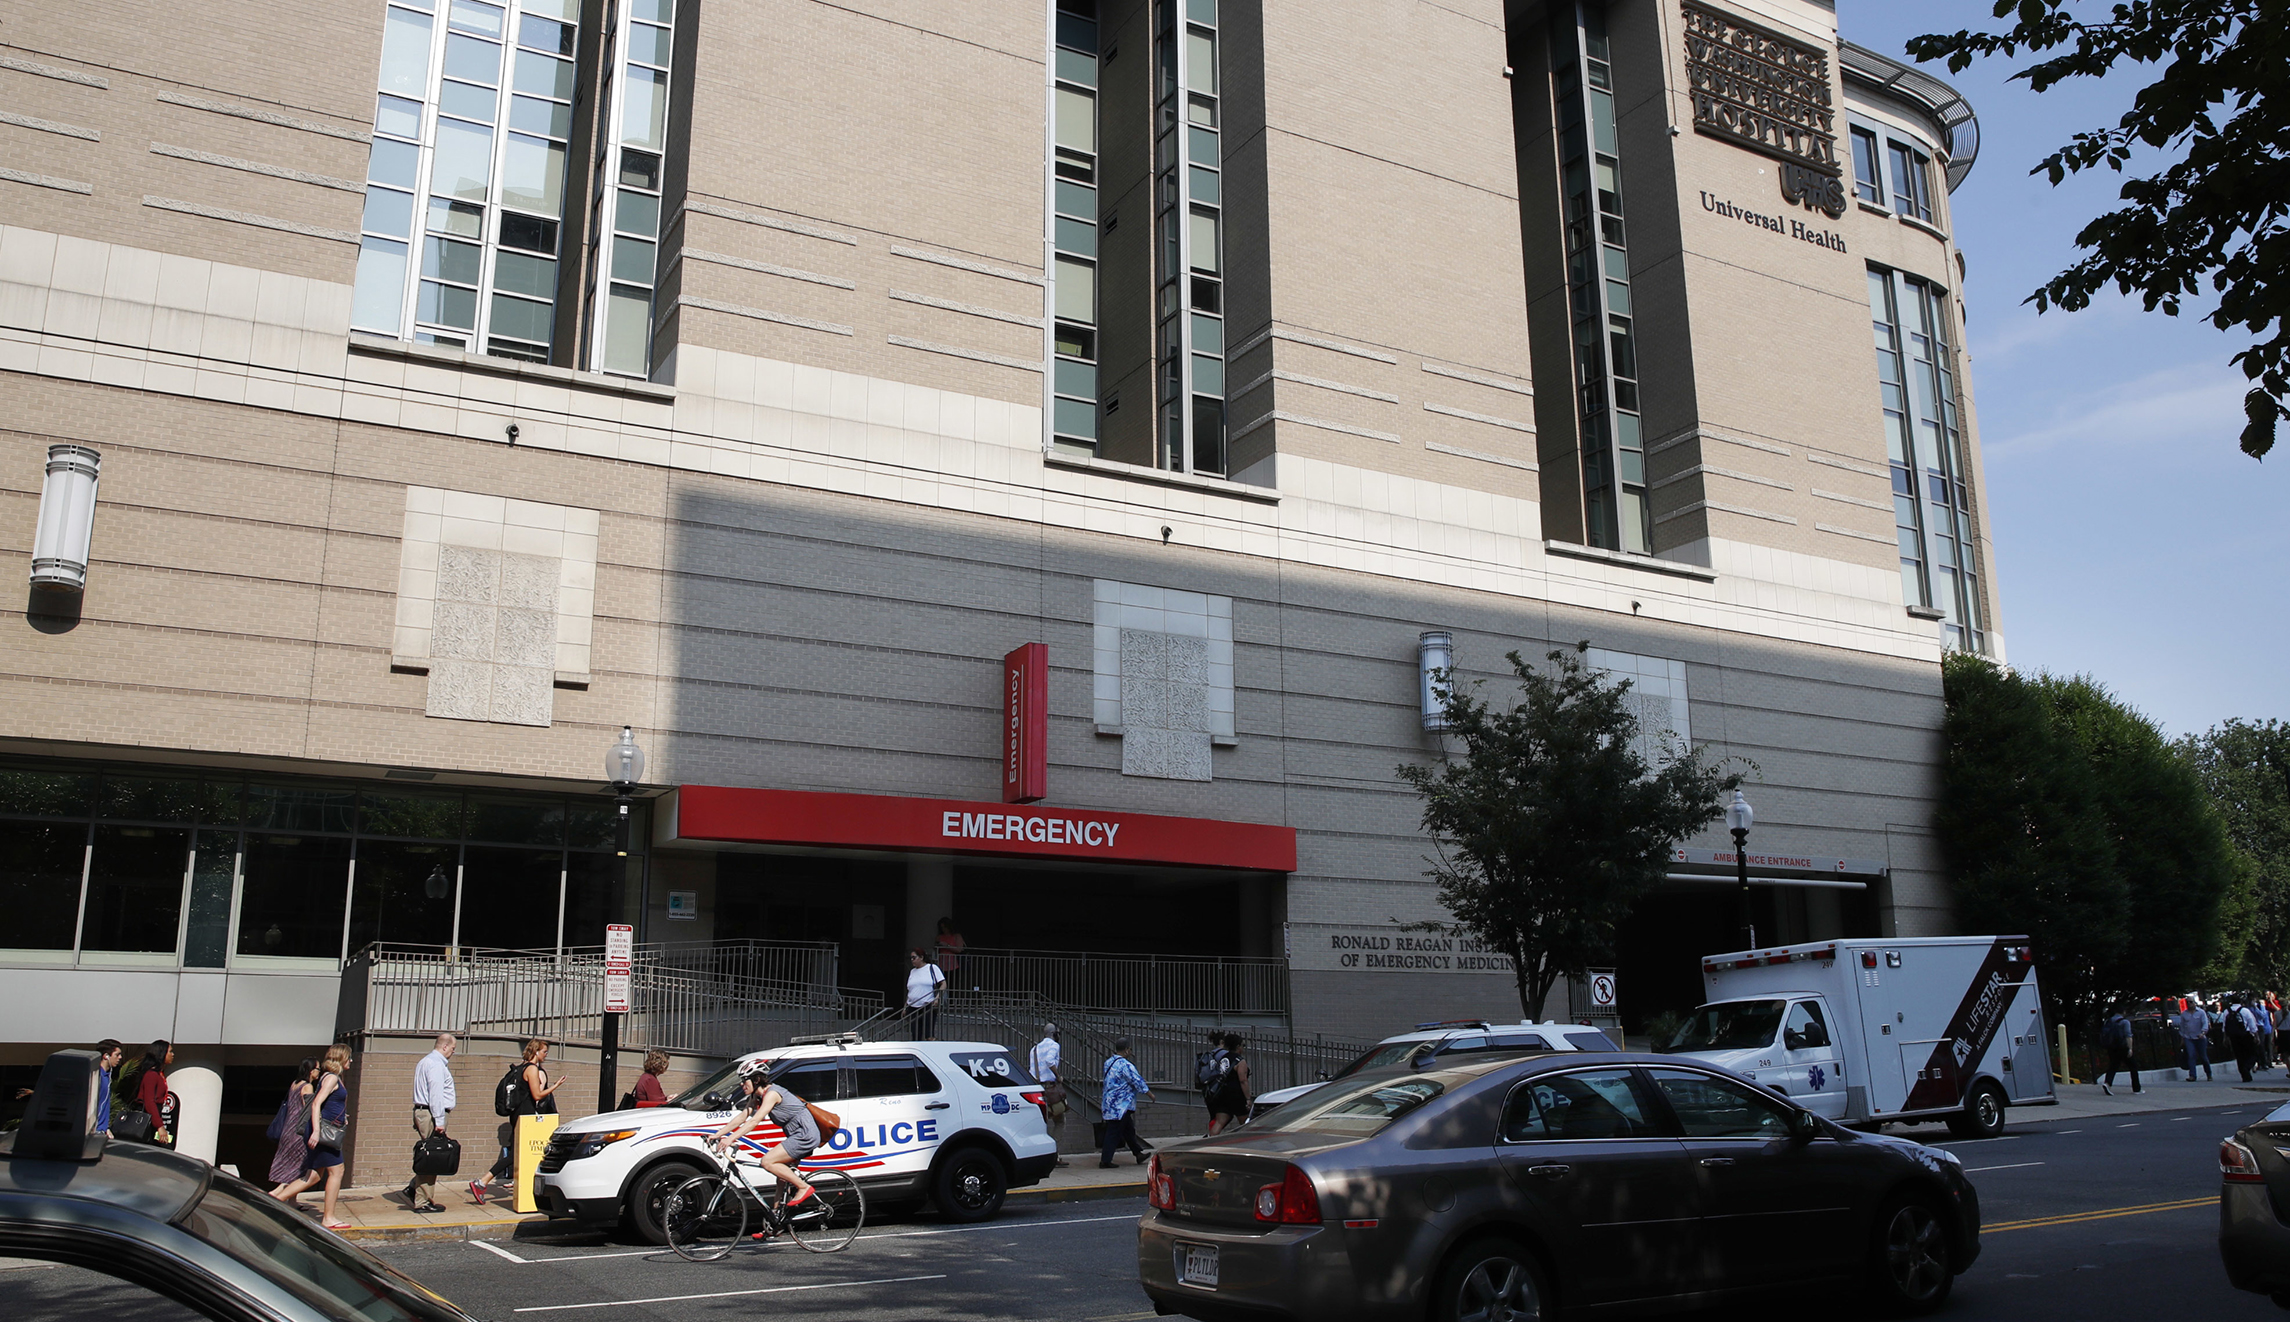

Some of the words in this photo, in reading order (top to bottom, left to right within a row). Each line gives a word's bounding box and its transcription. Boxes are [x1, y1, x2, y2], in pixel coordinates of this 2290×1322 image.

[1683, 9, 1728, 38] THE
[1731, 28, 1830, 80] GEORGE
[1685, 34, 1832, 107] WASHINGTON
[1689, 63, 1835, 133] UNIVERSITY
[1693, 94, 1841, 167] HOSPITAL
[1779, 161, 1847, 217] UHS
[1700, 191, 1785, 235] Universal
[1790, 219, 1847, 254] Health
[1009, 669, 1020, 783] Emergency
[942, 811, 1120, 847] EMERGENCY
[1713, 853, 1765, 866] AMBUNCE
[1768, 856, 1811, 868] ENTRANCE
[1331, 935, 1391, 950] RONALD
[1396, 937, 1452, 952] REAGAN
[1341, 953, 1359, 968] OF
[1366, 954, 1450, 969] EMERGENCY
[1457, 956, 1516, 971] MEDICIN
[1821, 960, 1834, 969] 249
[1966, 971, 2003, 1033] LIFESTAR
[968, 1058, 1010, 1077] K-9
[1759, 1059, 1771, 1067] 249
[706, 1110, 732, 1120] 8926
[828, 1118, 939, 1151] OLICE
